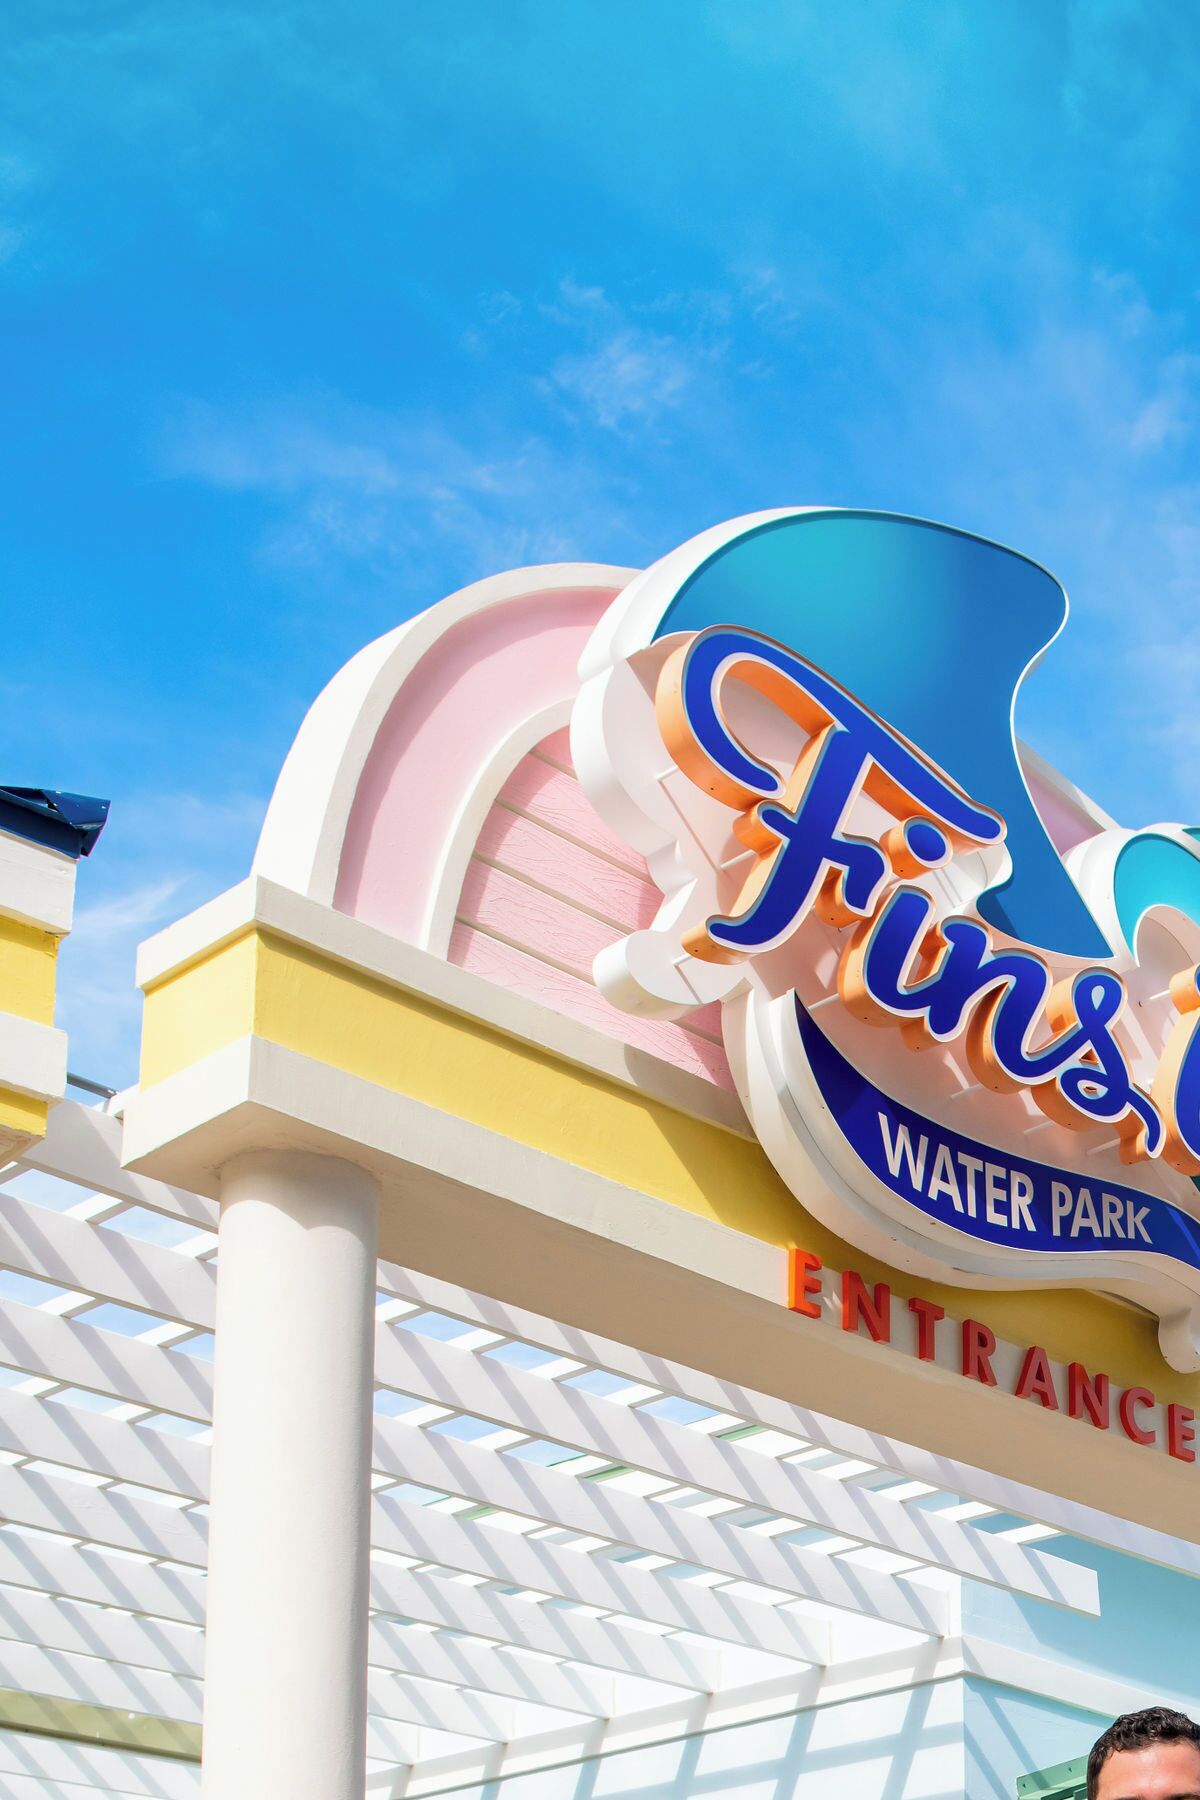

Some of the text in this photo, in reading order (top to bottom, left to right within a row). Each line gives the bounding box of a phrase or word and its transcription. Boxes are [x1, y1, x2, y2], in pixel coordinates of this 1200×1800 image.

[675, 624, 1162, 1160] Fins
[877, 1112, 1152, 1245] WATER PARK
[788, 1248, 1197, 1463] ENTRANCE
